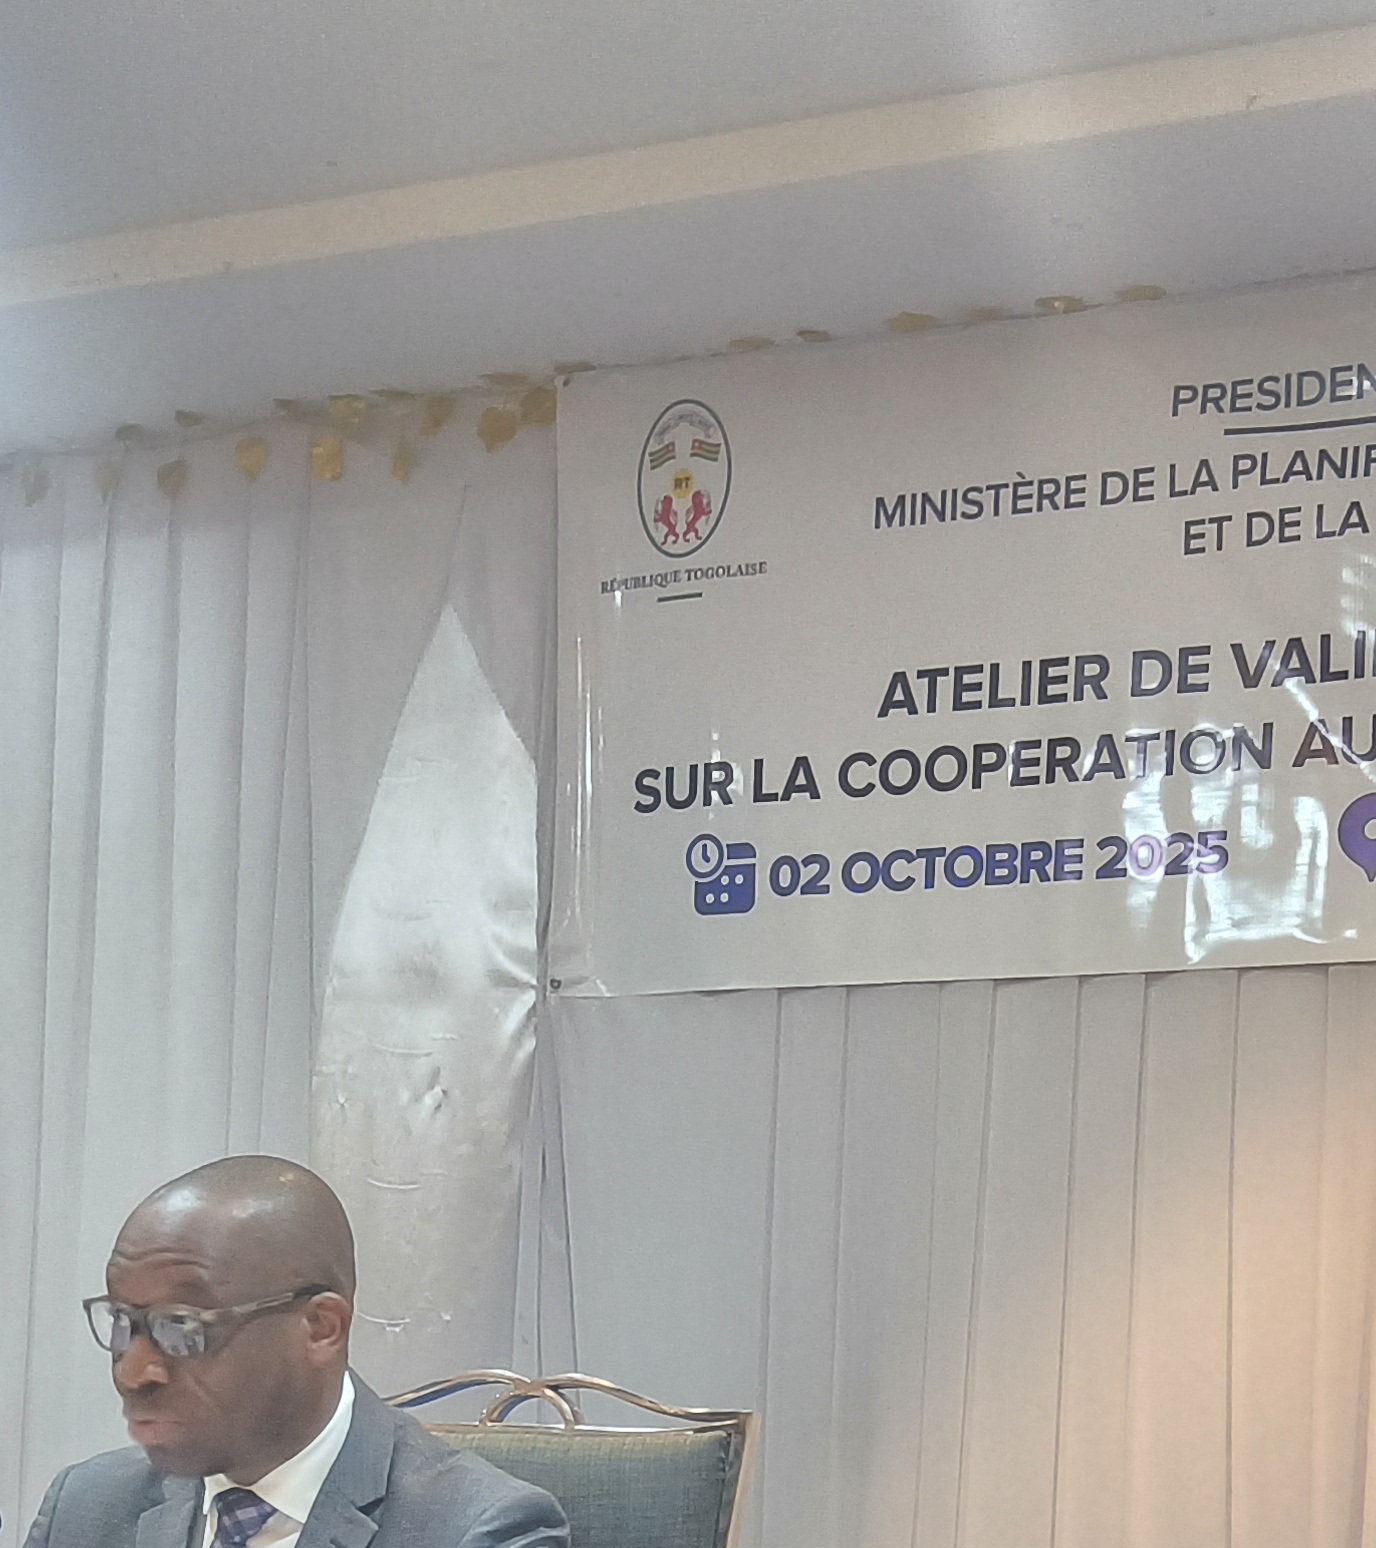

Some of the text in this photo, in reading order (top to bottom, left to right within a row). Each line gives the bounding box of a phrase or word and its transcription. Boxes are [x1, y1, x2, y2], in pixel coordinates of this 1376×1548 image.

[874, 471, 1087, 530] MINISTÈRE
[1099, 467, 1155, 506] DE
[1168, 457, 1220, 498] LA
[1183, 516, 1232, 555] ET
[1245, 509, 1302, 548] DE
[1315, 501, 1369, 538] LA
[601, 561, 767, 595] RÉPUBLIQUE TOGOLAISE
[877, 654, 1110, 719] ATELIER
[1130, 645, 1212, 698] DE
[633, 760, 736, 814] SUR
[752, 756, 821, 804] LA
[837, 722, 1273, 799] COOPERATION
[768, 830, 1229, 897] 02 OCTOBRE 2025
